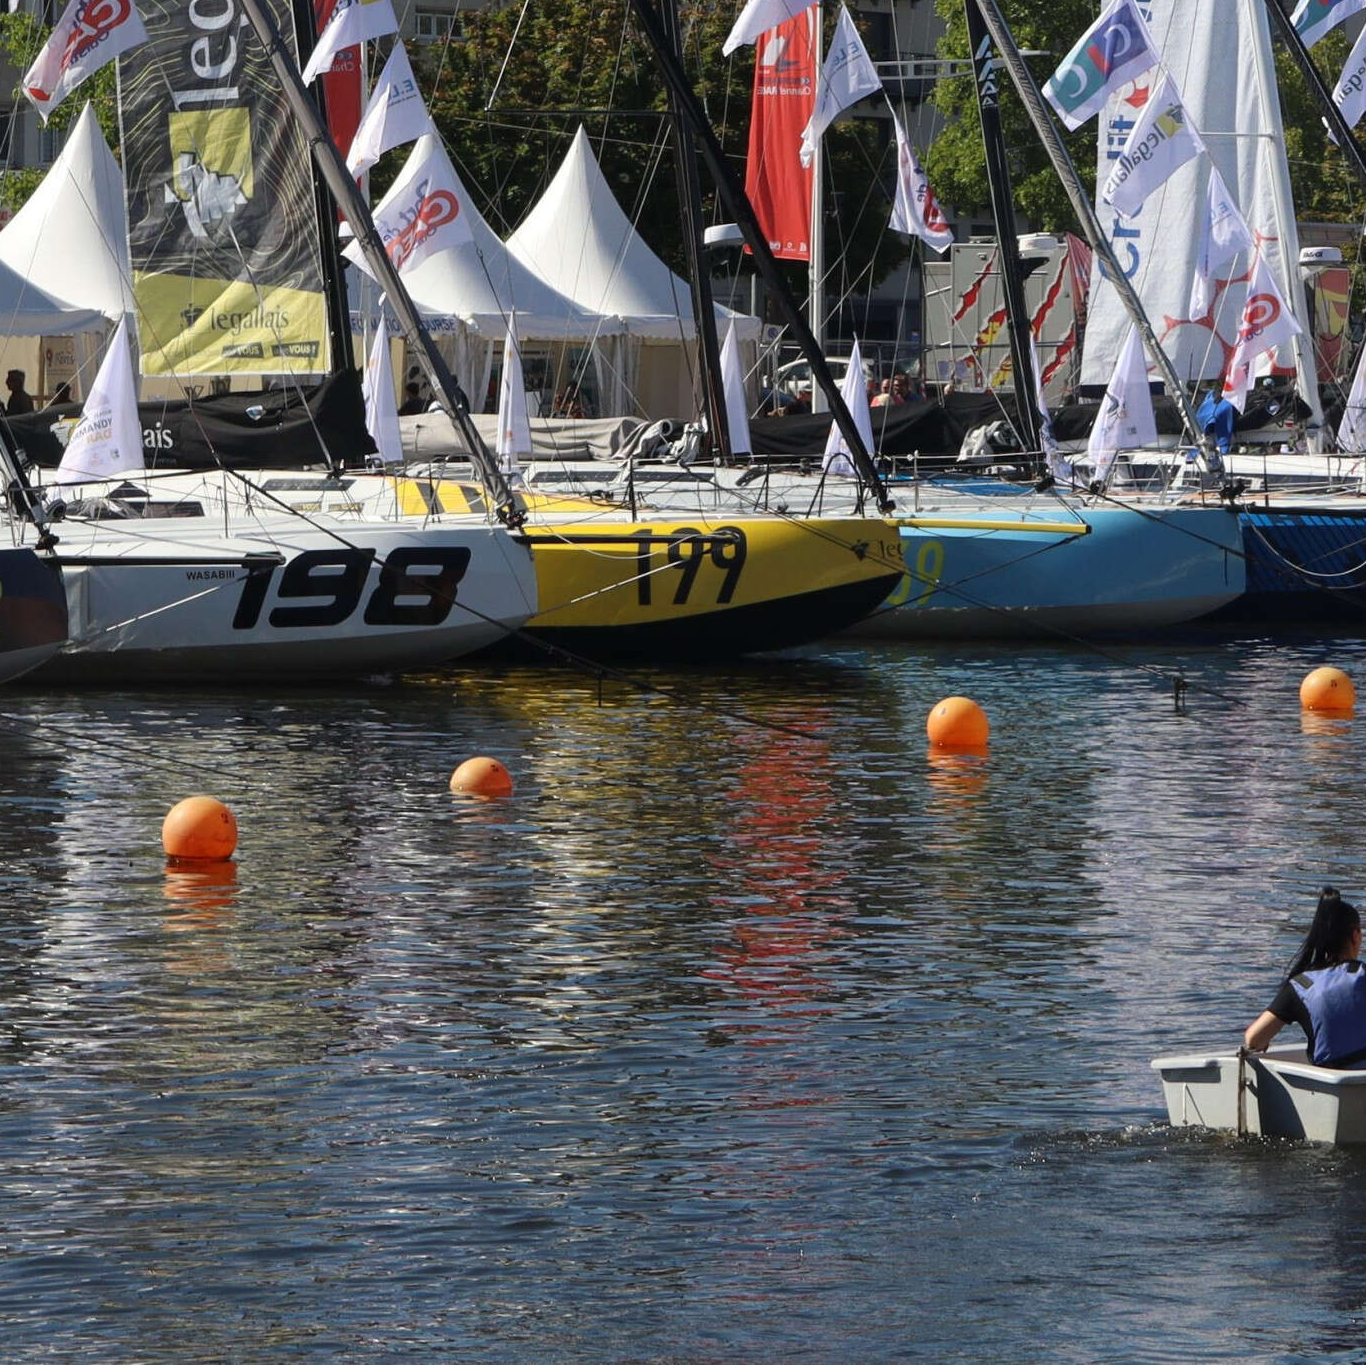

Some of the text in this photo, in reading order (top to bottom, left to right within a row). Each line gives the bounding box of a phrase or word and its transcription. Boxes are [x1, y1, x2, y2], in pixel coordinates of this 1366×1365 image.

[211, 305, 289, 335] legallais
[233, 547, 472, 629] 198
[634, 526, 747, 606] 199
